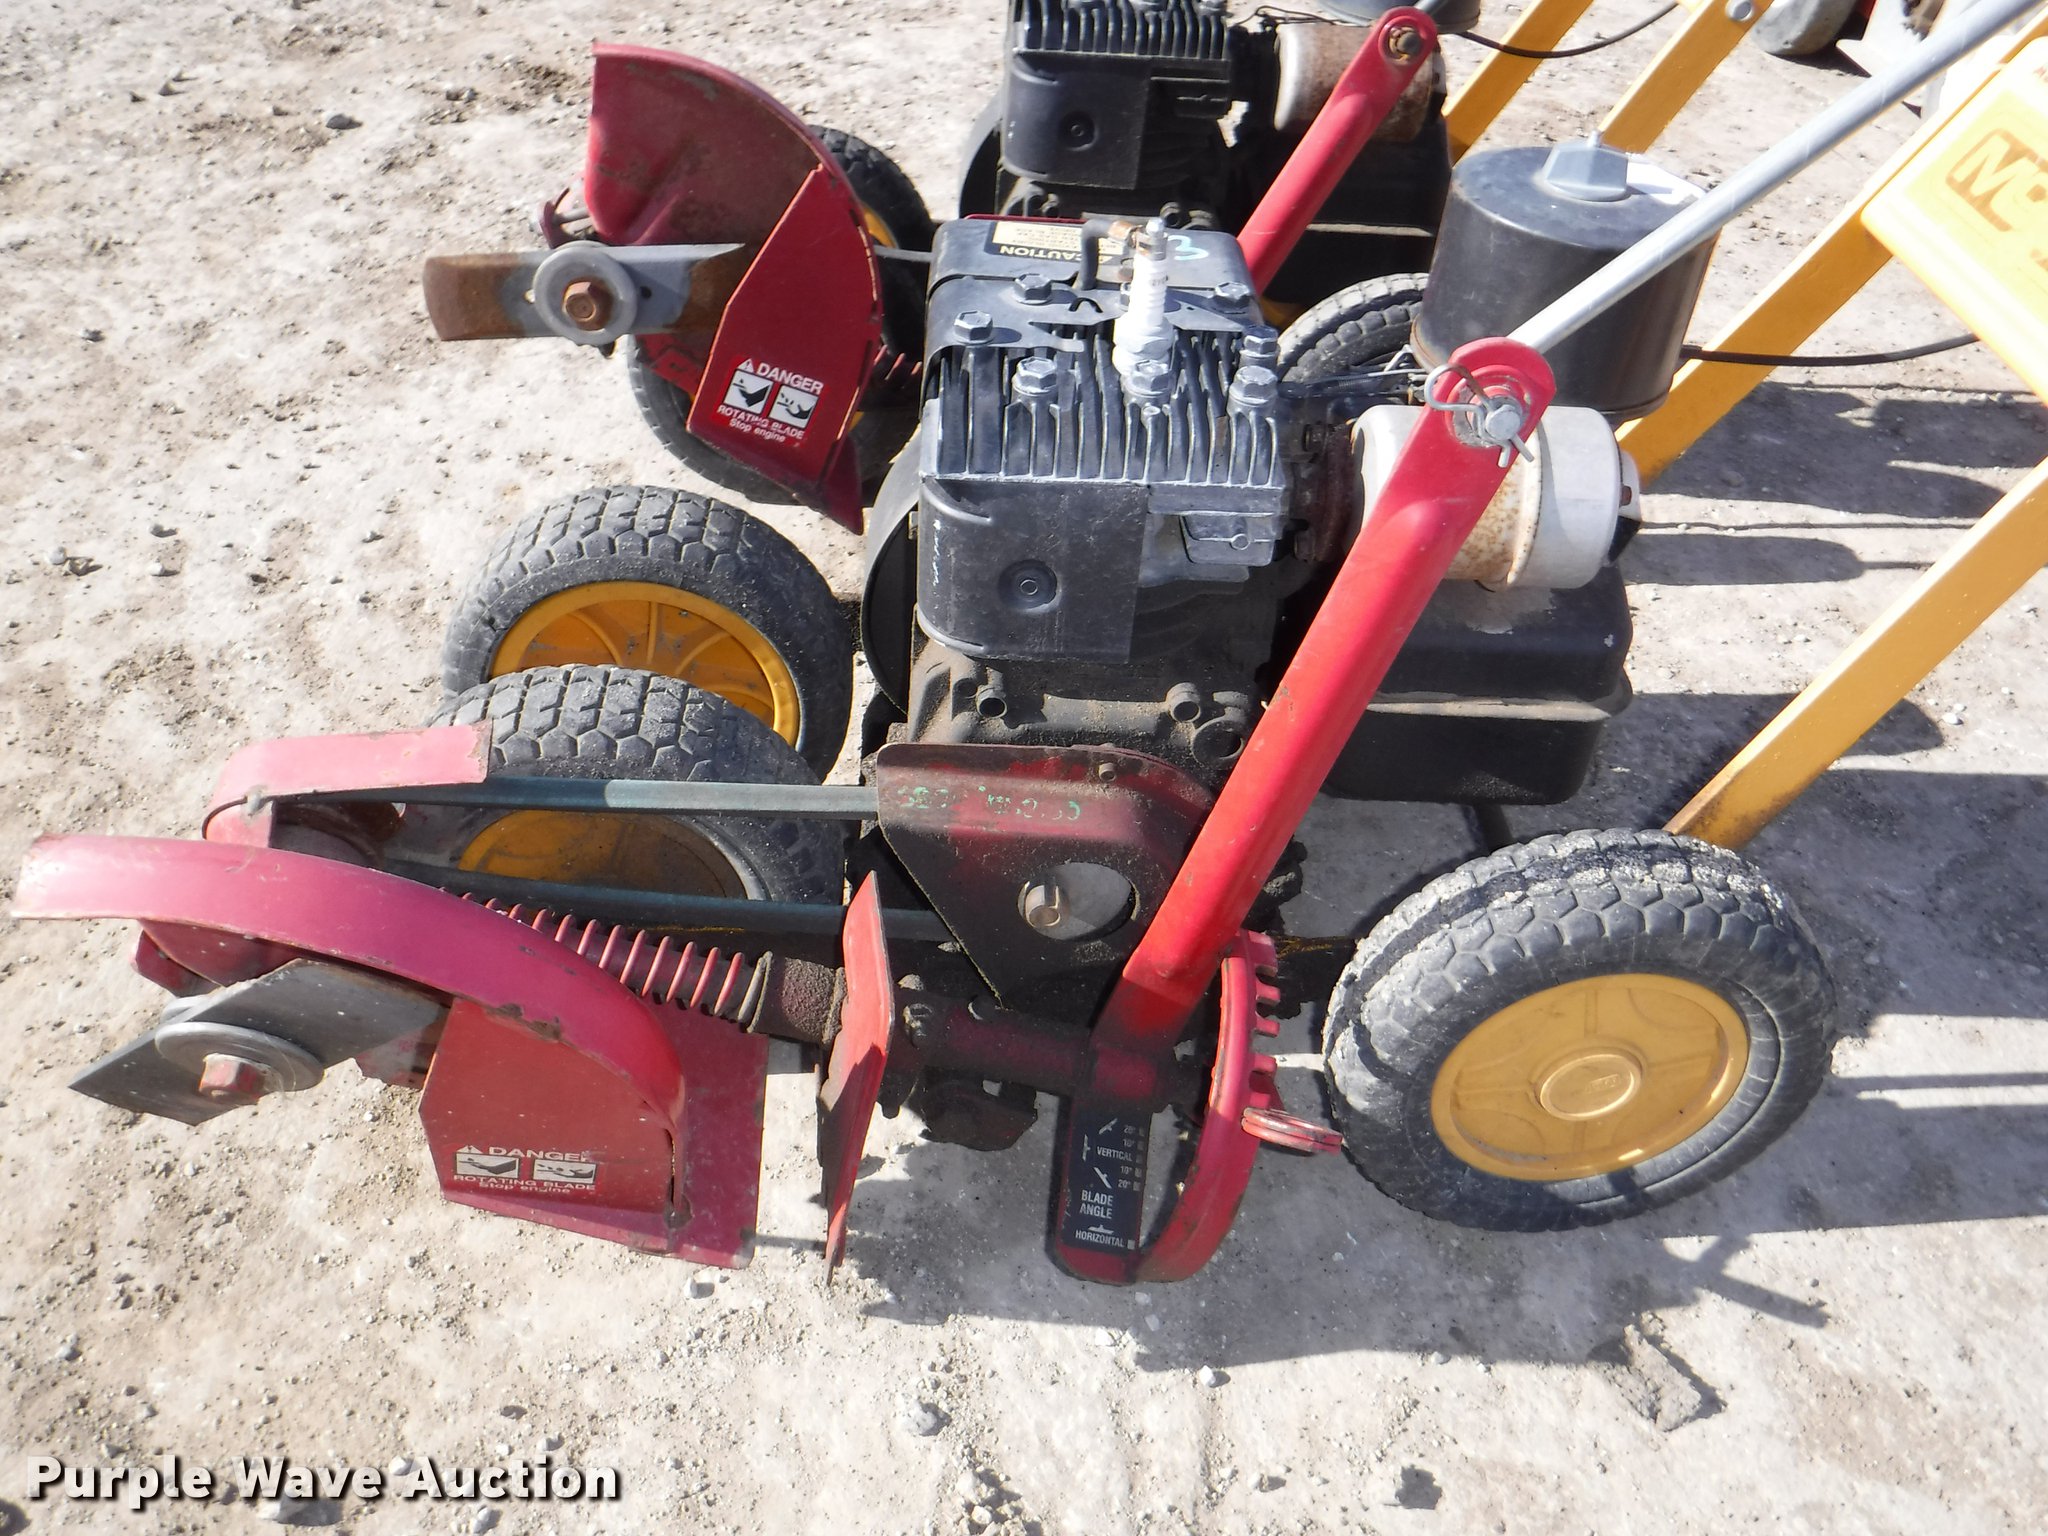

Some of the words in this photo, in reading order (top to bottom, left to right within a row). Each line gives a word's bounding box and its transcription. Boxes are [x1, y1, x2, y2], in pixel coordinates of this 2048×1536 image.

[757, 363, 824, 395] DANGER
[716, 404, 769, 428] ROTATING
[770, 422, 805, 440] BLADE
[729, 418, 751, 433] Stop
[755, 428, 786, 442] engine
[1096, 1146, 1133, 1162] VERTICAL
[453, 1174, 537, 1187] ROTATING
[543, 1181, 596, 1191] BLADE
[479, 1181, 514, 1191] Stop
[520, 1185, 571, 1194] engine
[1081, 1189, 1114, 1206] BLADE
[1079, 1203, 1113, 1220] ANGLE
[1075, 1229, 1125, 1248] HORIZONTAL
